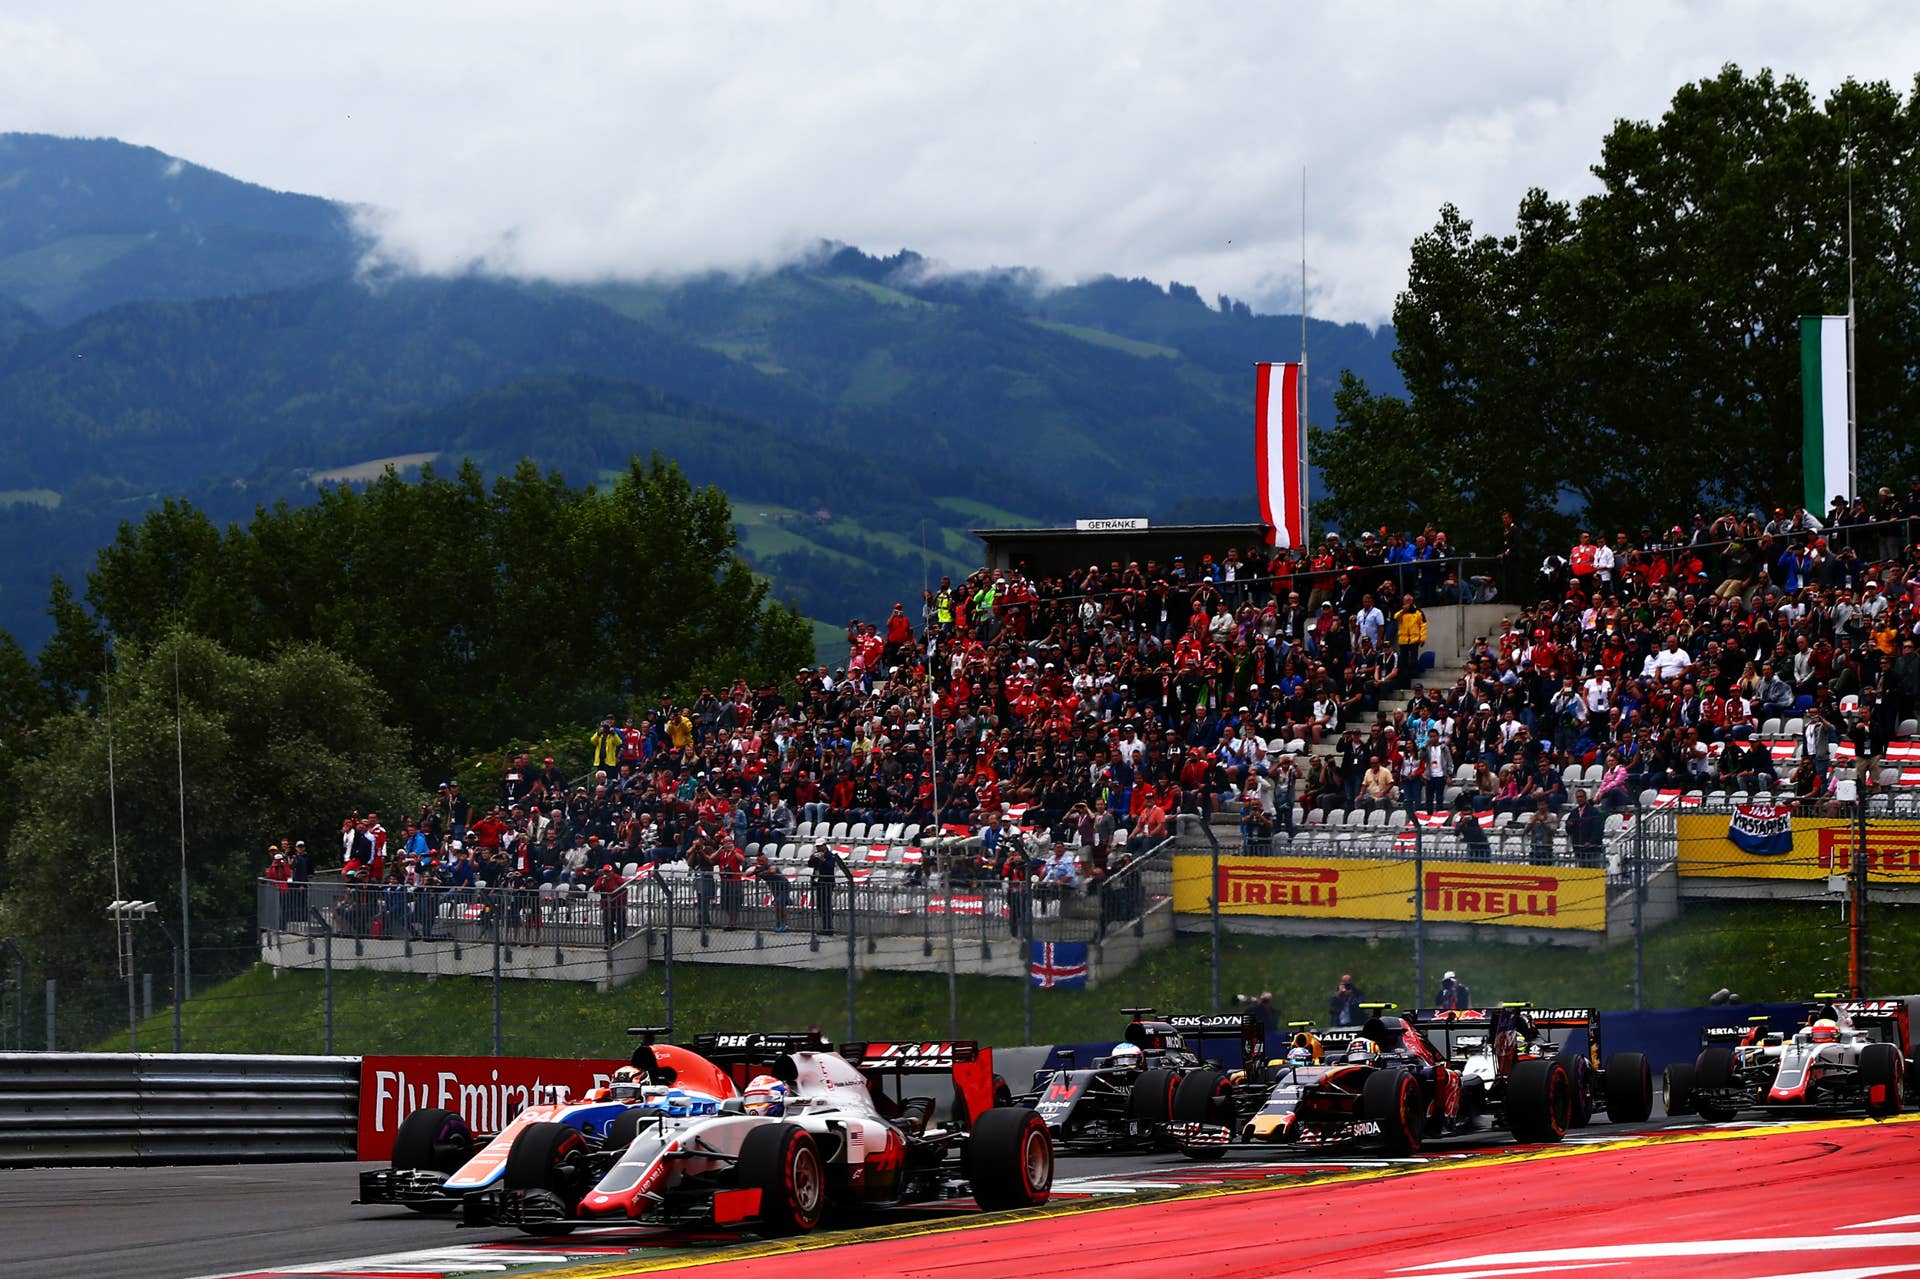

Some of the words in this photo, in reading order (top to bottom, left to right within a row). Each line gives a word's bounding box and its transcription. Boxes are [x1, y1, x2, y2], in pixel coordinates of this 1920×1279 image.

[1088, 520, 1136, 529] GETRÄNKE
[1748, 805, 1776, 818] MAX
[1217, 865, 1339, 907] PIRELLI
[1424, 871, 1558, 916] PIRELLI
[375, 1070, 429, 1132] Fly
[437, 1068, 571, 1132] Emirat
[1050, 1084, 1078, 1101] 14
